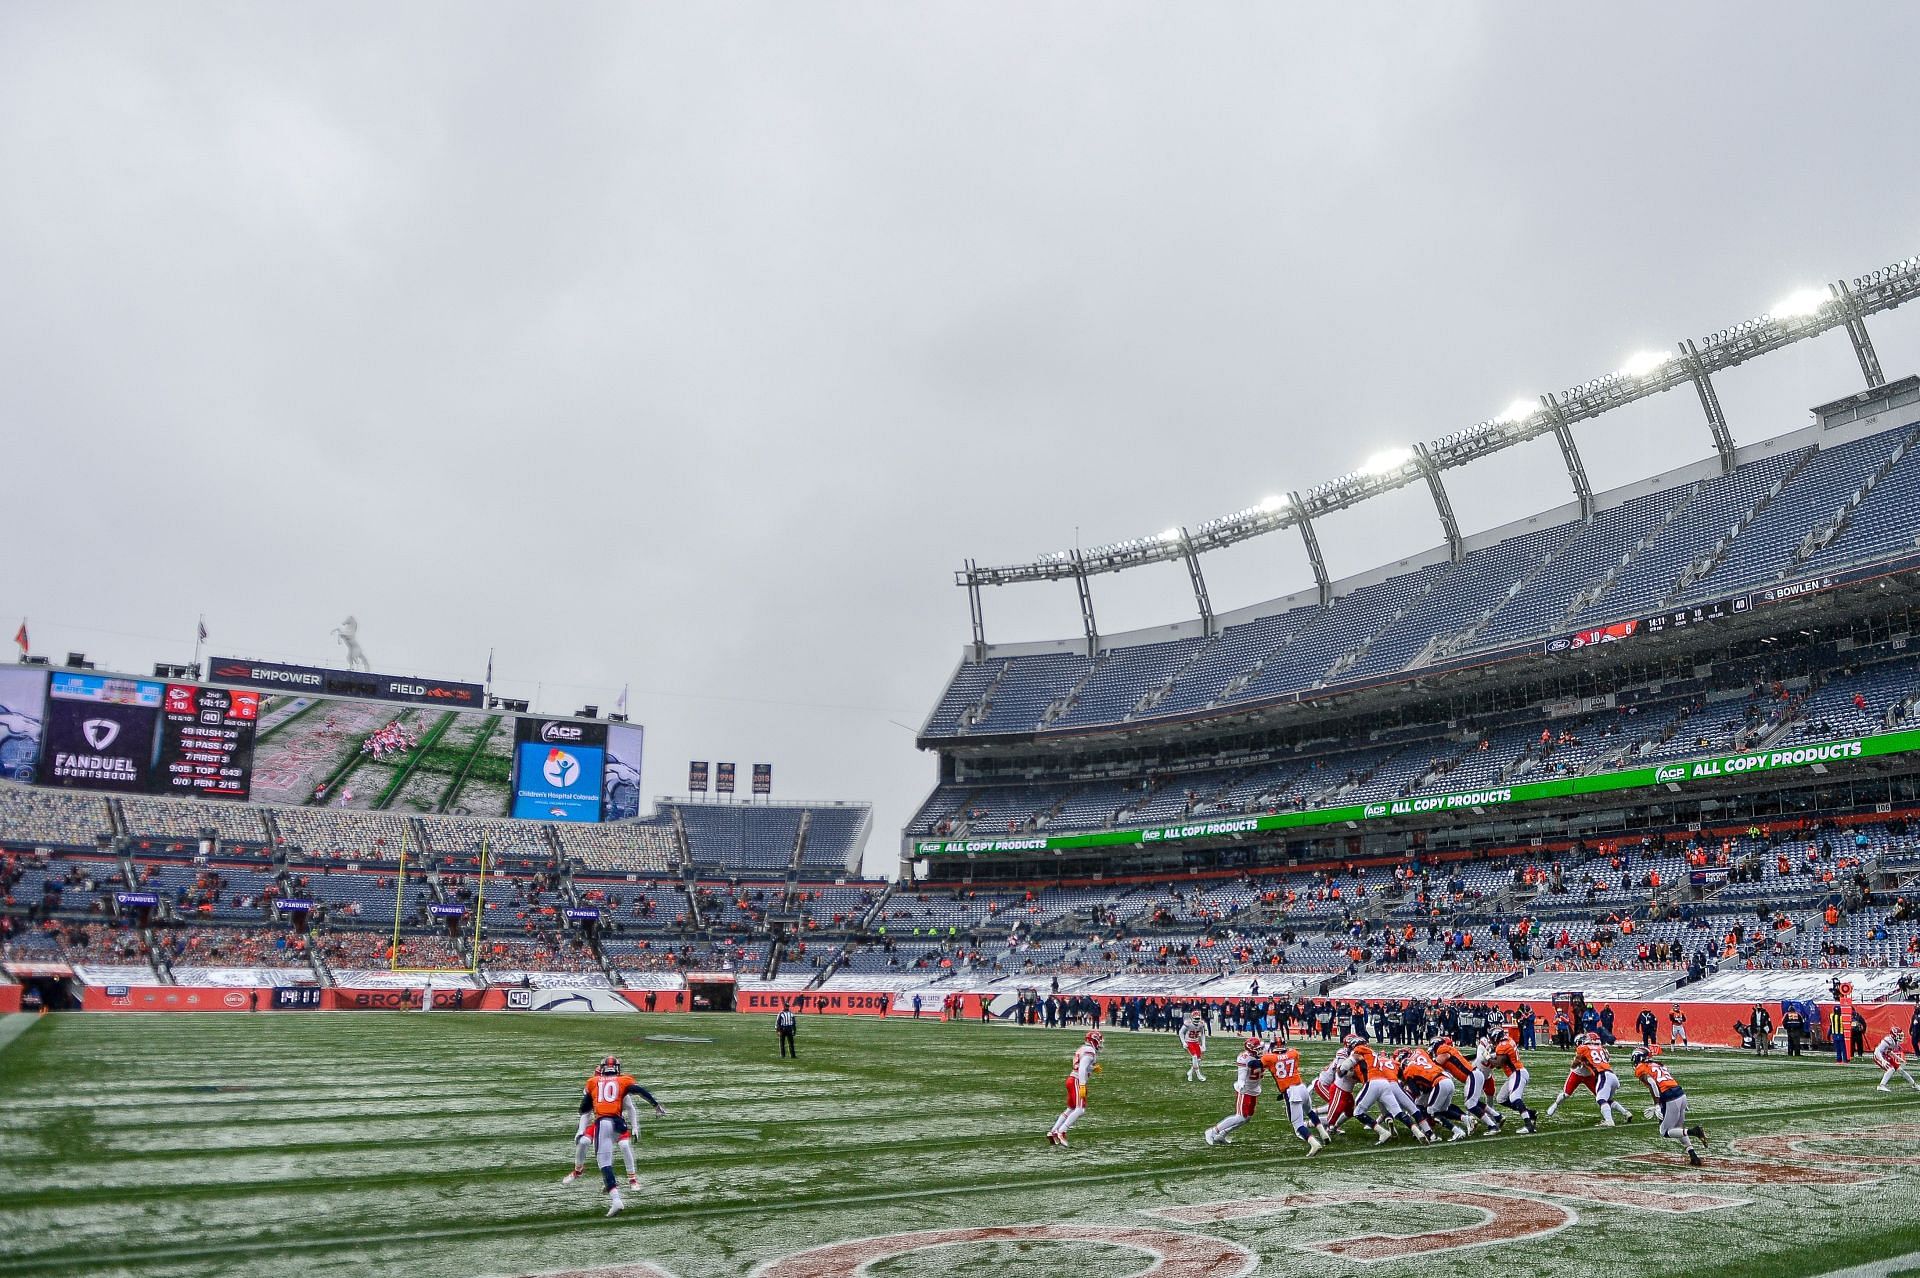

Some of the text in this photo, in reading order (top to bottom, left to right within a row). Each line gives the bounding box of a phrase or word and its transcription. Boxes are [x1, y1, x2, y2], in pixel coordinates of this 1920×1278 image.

[1776, 583, 1819, 599] BOWLEN
[1735, 600, 1745, 610] 40
[1648, 617, 1665, 628] 14:11
[1675, 612, 1686, 622] 1ST
[1625, 624, 1632, 635] 6
[1590, 631, 1600, 643] 10
[1550, 640, 1567, 650] Ford
[250, 668, 322, 686] EMPOWER
[206, 691, 220, 699] 2nd
[389, 683, 425, 697] FIELD
[172, 700, 187, 710] 10
[199, 698, 228, 709] 14:12
[203, 712, 217, 721] 40
[242, 708, 251, 716] 6
[181, 727, 237, 739] 49 RUSH 24
[547, 725, 582, 737] ACP
[181, 740, 237, 752] 78 PASS 47
[55, 752, 137, 773] FANDUEL
[185, 753, 192, 761] 7
[193, 753, 220, 763] FIRST
[1692, 741, 1862, 777] ALL COPY PRODUCTS
[54, 767, 136, 781] SPORTSBOOK
[169, 764, 242, 777] 9:05 TOP 6:43
[1659, 769, 1685, 778] ACP
[172, 778, 191, 786] 0/0
[194, 780, 214, 788] PEN
[518, 790, 547, 798] Children's
[548, 792, 573, 800] Hospital
[1391, 789, 1511, 815] ALL COPY PRODUCTS
[1367, 806, 1386, 815] ACP
[1877, 804, 1890, 812] 106
[1163, 819, 1258, 839] ALL COPY PRODUCTS
[945, 839, 1047, 852] ALL COPY PRODUCTS
[127, 895, 156, 903] FANDUEL
[284, 901, 310, 909] FANDUEL
[438, 906, 463, 914] FANDUEL
[355, 993, 463, 1006] BRONO
[511, 992, 529, 1004] 40
[750, 995, 881, 1009] ELEVTION 5280
[1275, 1059, 1295, 1079] 87
[597, 1081, 618, 1103] 10
